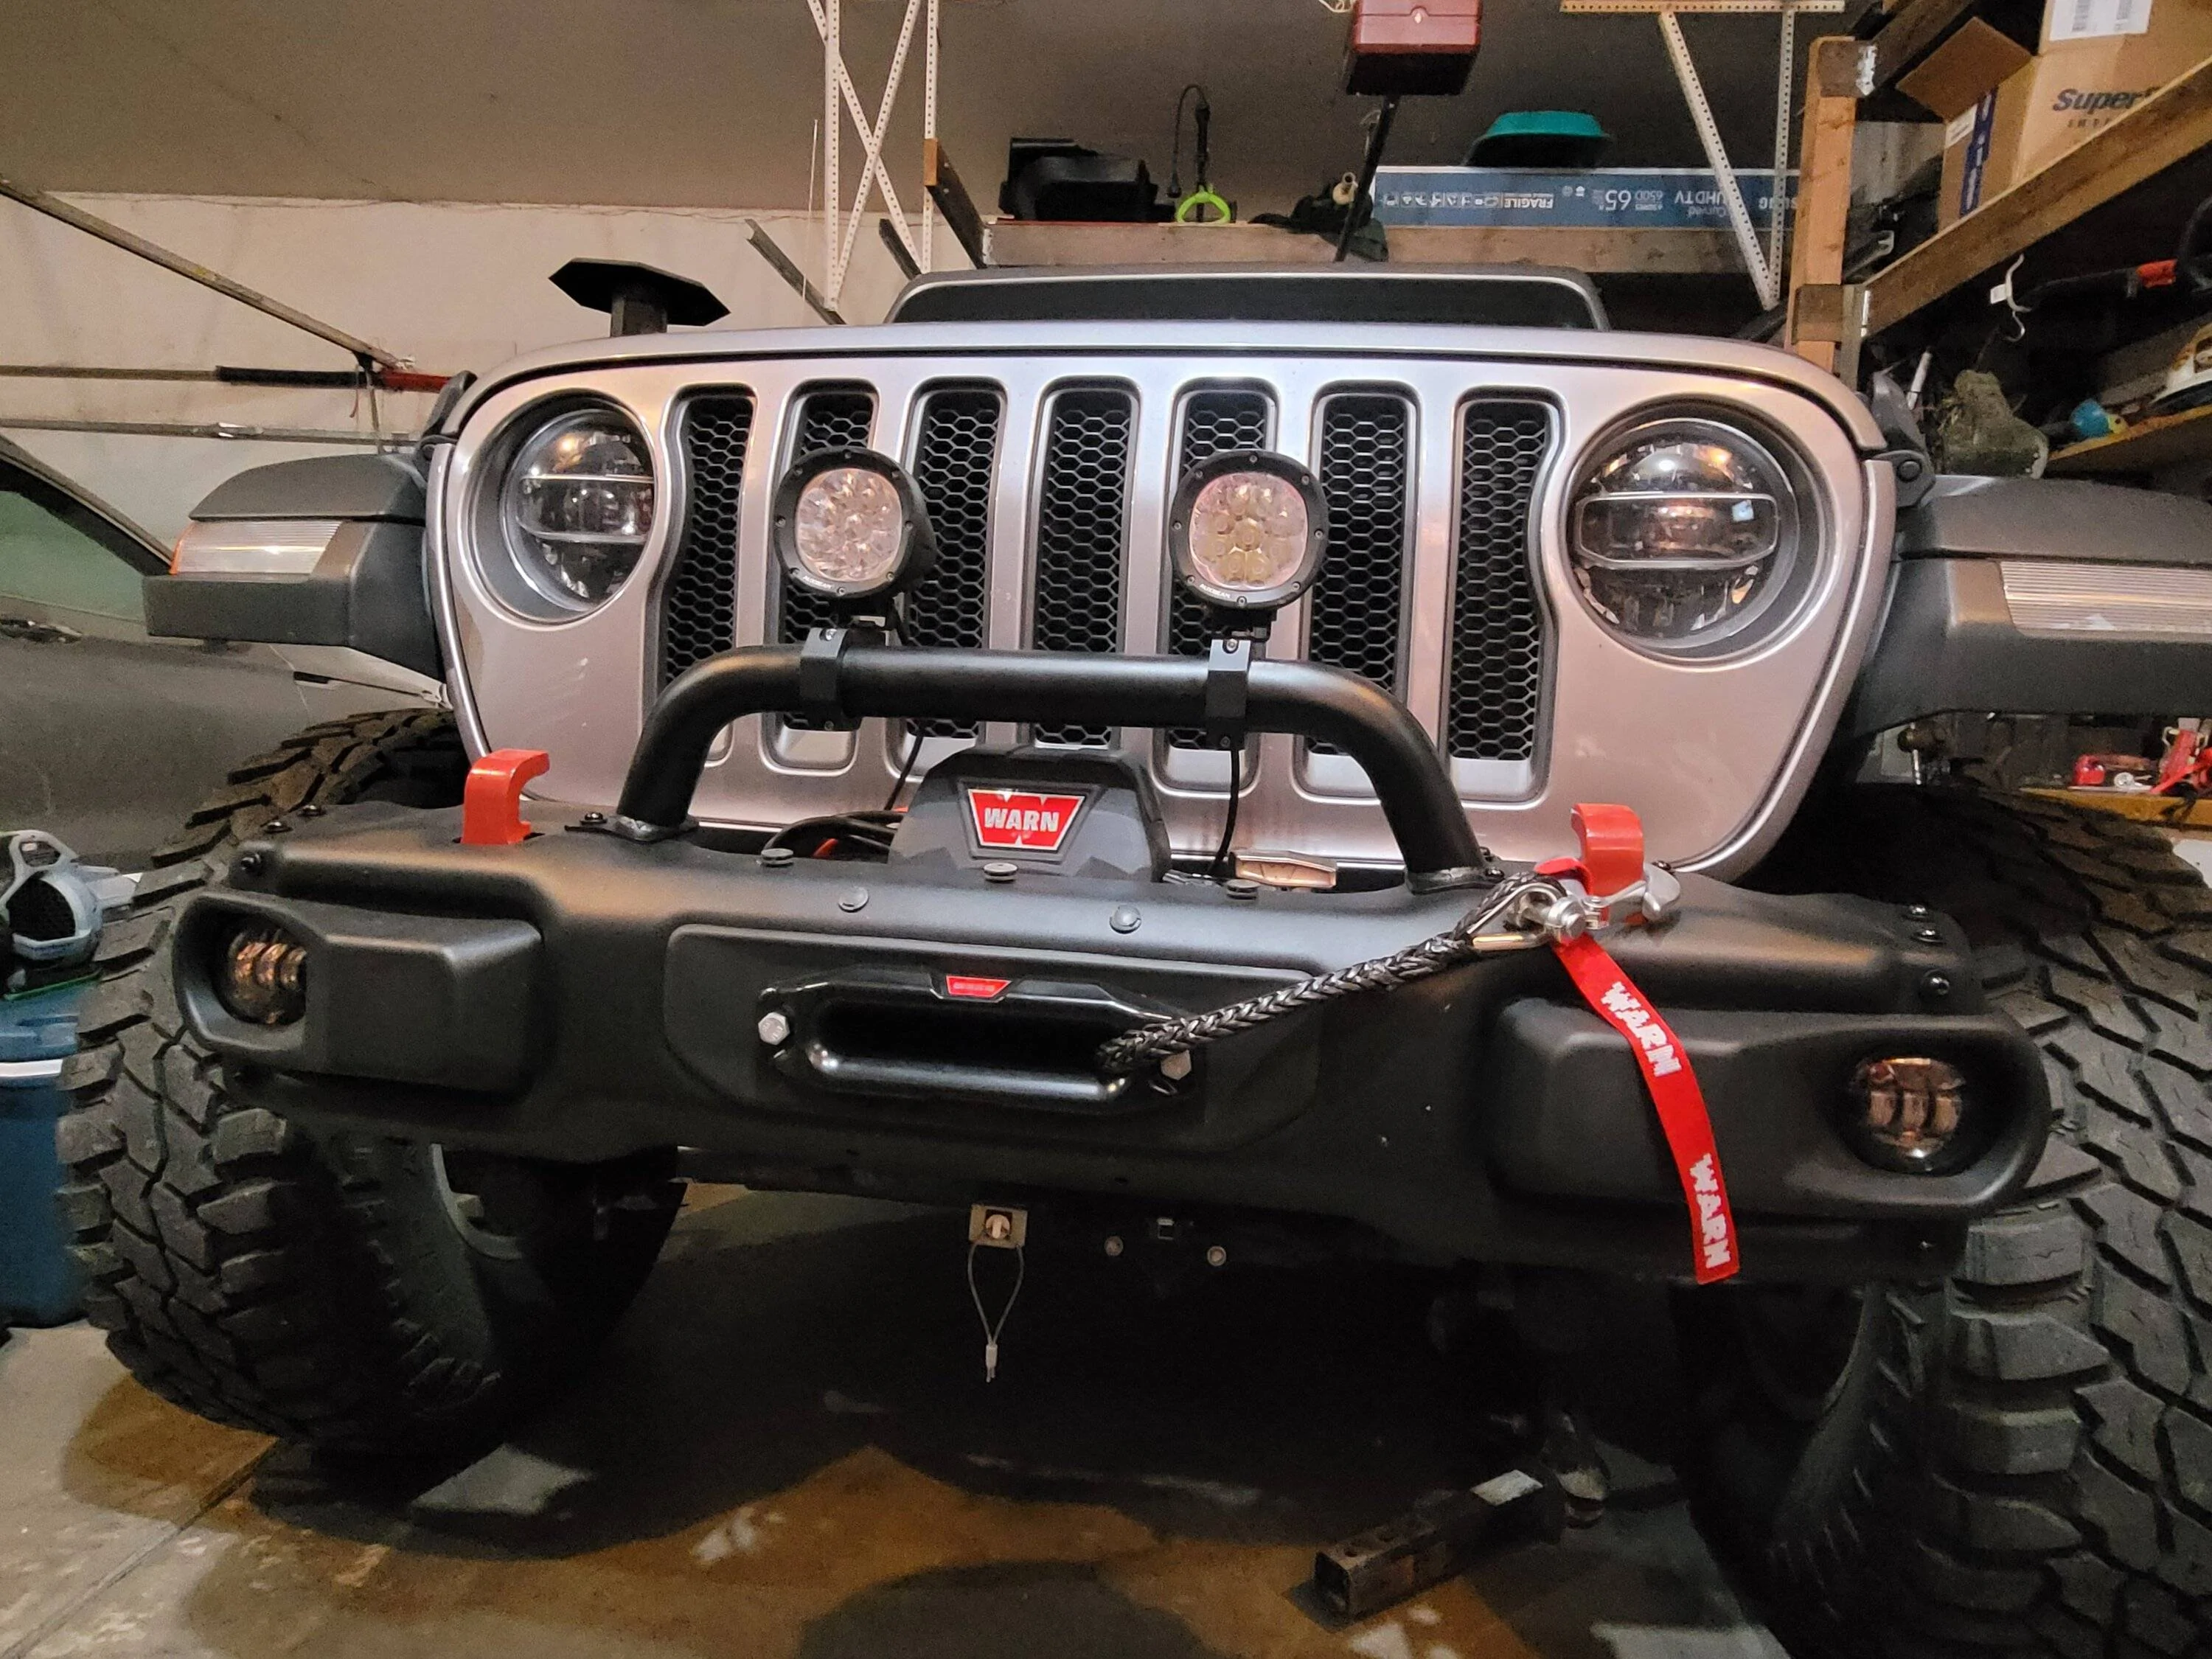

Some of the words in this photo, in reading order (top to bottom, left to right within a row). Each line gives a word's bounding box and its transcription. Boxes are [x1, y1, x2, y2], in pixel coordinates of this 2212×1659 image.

[1504, 198, 1554, 209] FRAGILE
[984, 807, 1060, 832] WARN
[1601, 981, 1682, 1077] WARN
[1690, 1153, 1731, 1268] WARN
